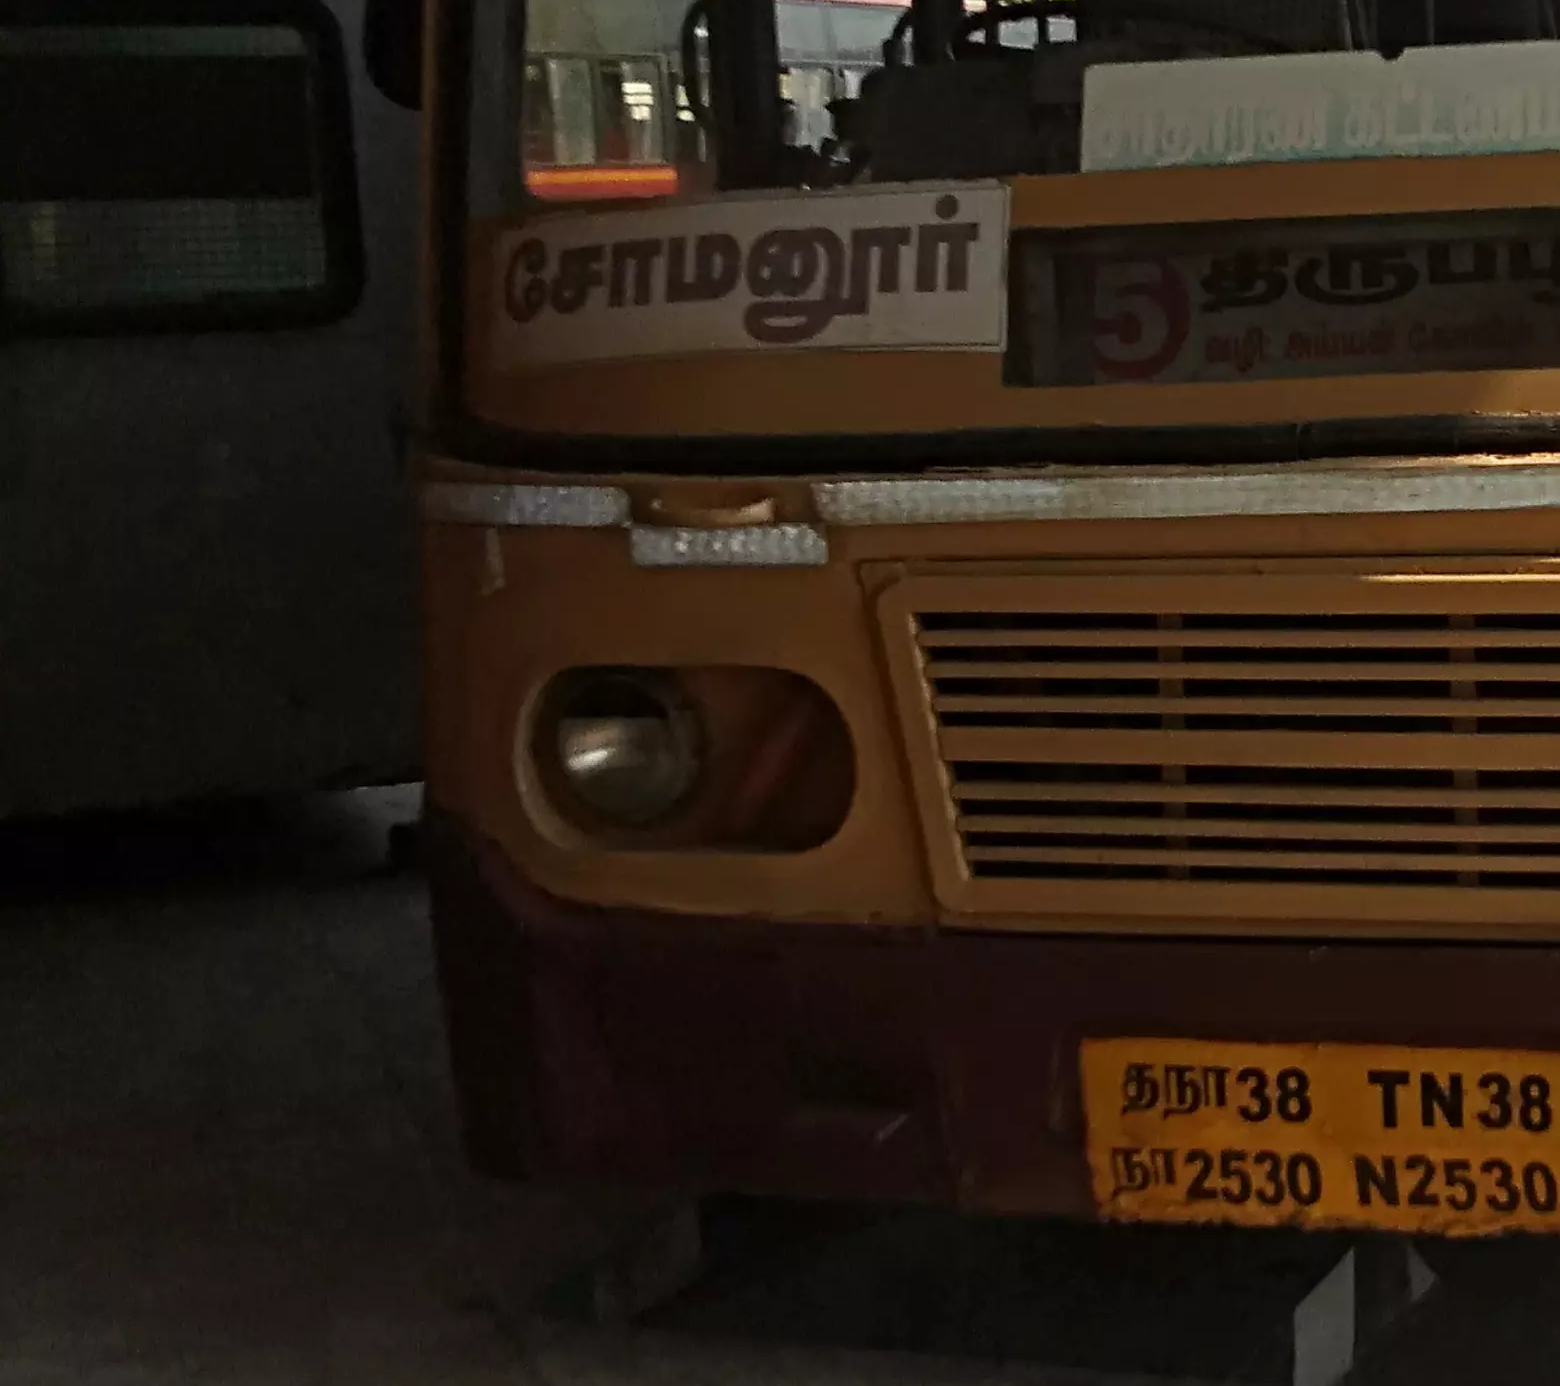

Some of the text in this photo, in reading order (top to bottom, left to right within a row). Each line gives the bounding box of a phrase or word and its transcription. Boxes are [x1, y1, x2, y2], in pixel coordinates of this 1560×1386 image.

[504, 193, 980, 343] சோமனூர்
[1092, 262, 1171, 366] 5
[1367, 1069, 1554, 1133] TN38
[1354, 1154, 1559, 1213] N2530
